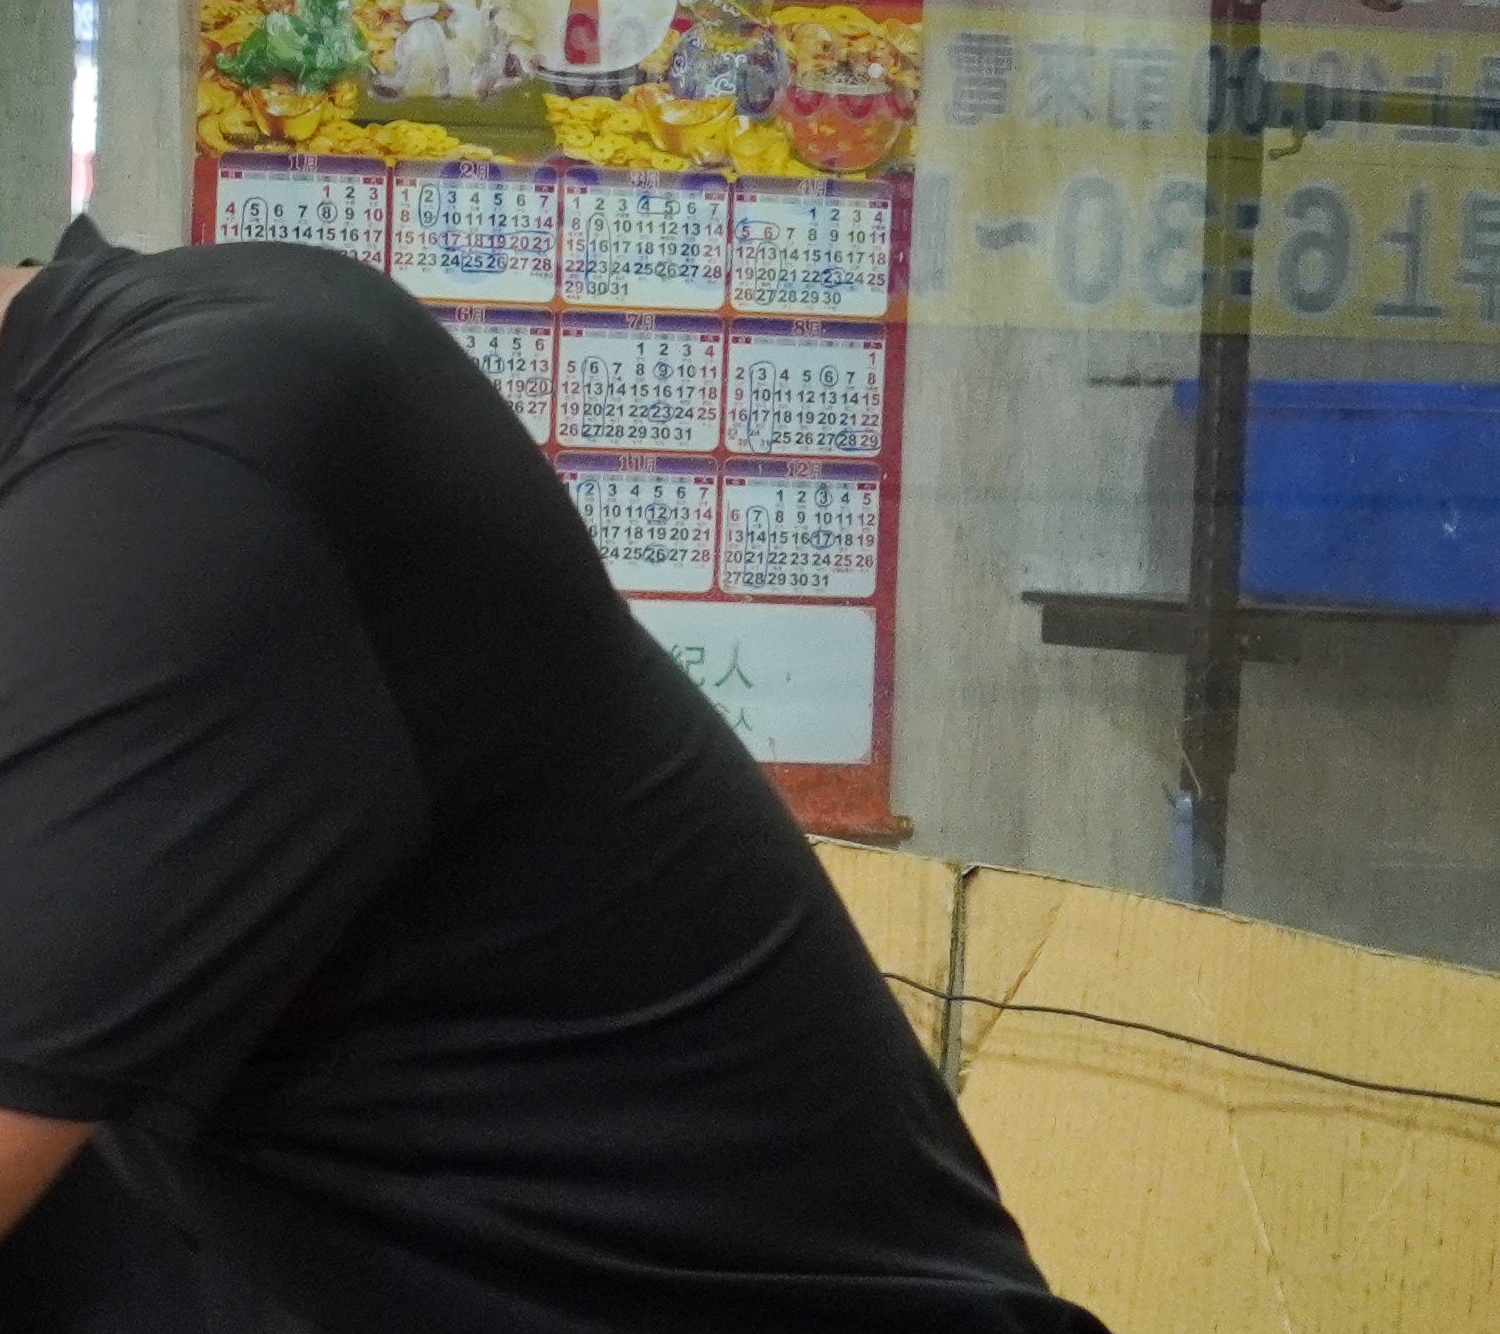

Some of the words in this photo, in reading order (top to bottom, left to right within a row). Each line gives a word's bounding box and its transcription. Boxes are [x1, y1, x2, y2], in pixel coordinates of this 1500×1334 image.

[637, 343, 643, 355] 1
[659, 344, 668, 356] 2
[682, 345, 691, 357] 3
[705, 346, 713, 358] 4
[567, 361, 575, 373] 5
[590, 362, 598, 374] 6
[612, 363, 621, 375] 7
[636, 364, 644, 376] 8
[659, 365, 668, 377] 9
[677, 365, 695, 377] 10
[701, 366, 717, 378] 11
[562, 382, 580, 394] 12
[584, 383, 603, 395] 13
[607, 384, 626, 396] 14
[630, 384, 649, 396] 15
[653, 386, 671, 398] 16
[676, 387, 694, 399] 17
[699, 387, 717, 399] 18
[561, 403, 579, 415] 19
[584, 404, 602, 416] 20
[606, 405, 624, 417] 21
[629, 405, 648, 417] 22
[652, 406, 671, 418] 23
[675, 407, 694, 419] 24
[698, 408, 717, 420] 25
[559, 424, 578, 436] 26
[582, 425, 601, 437] 27
[606, 426, 624, 438] 28
[628, 426, 647, 438] 29
[651, 427, 670, 439] 30
[674, 428, 692, 440] 31
[777, 491, 783, 503] 1
[797, 491, 805, 503] 2
[819, 492, 828, 504] 3
[841, 492, 850, 504] 4
[863, 493, 871, 505] 5
[730, 510, 739, 522] 6
[753, 510, 762, 522] 7
[775, 511, 783, 523] 8
[796, 511, 805, 523] 9
[814, 512, 833, 524] 10
[837, 513, 853, 525] 11
[858, 514, 876, 526] 12
